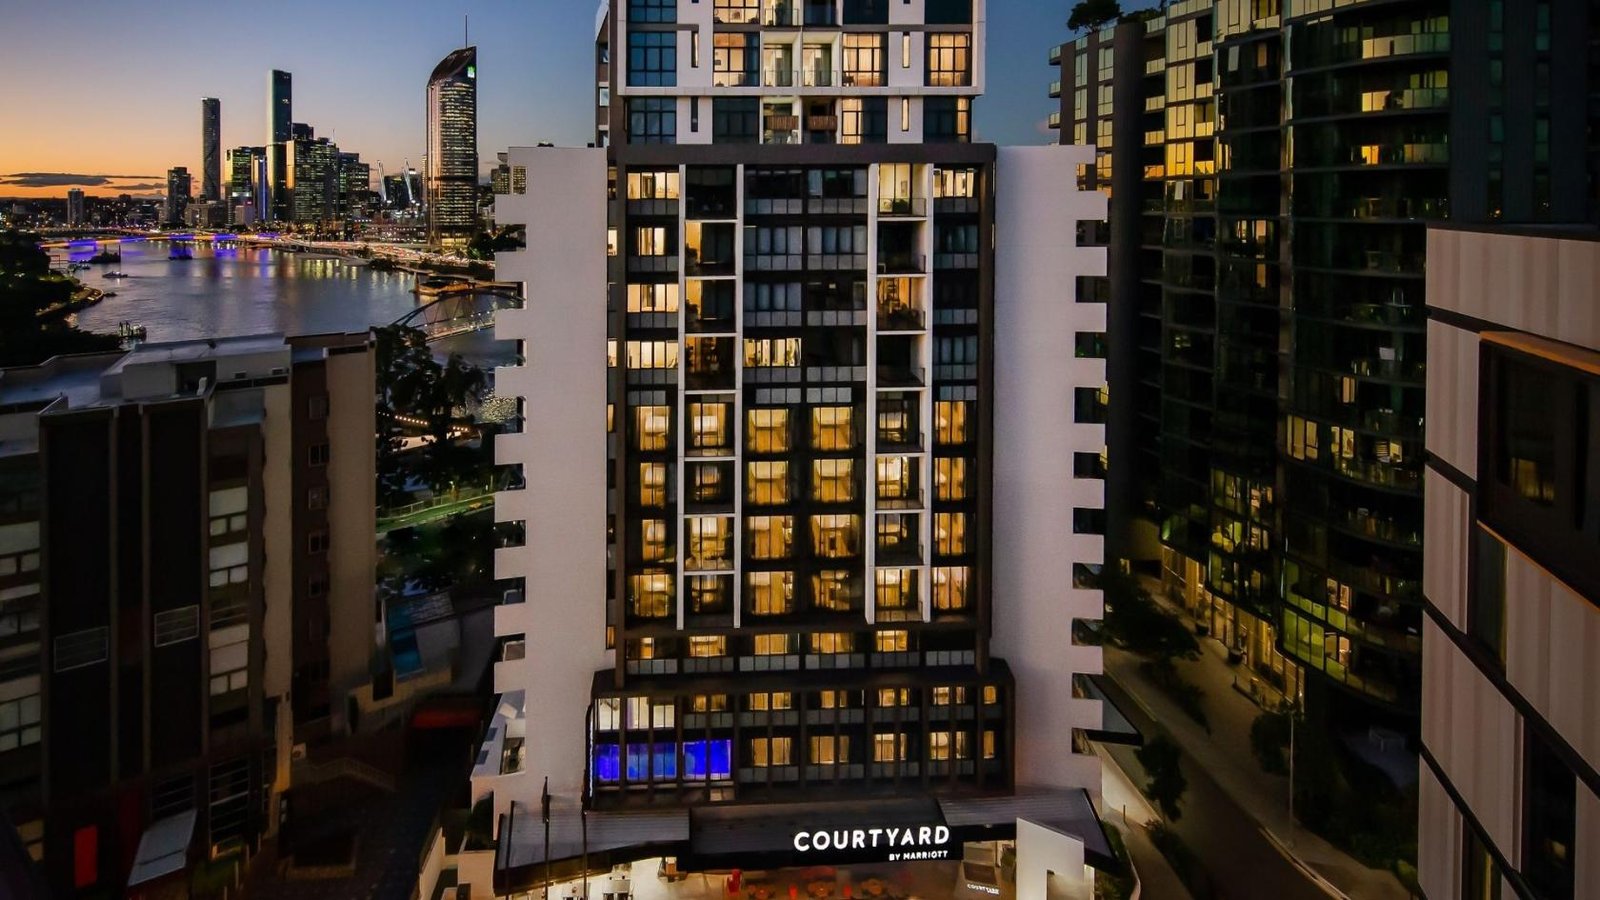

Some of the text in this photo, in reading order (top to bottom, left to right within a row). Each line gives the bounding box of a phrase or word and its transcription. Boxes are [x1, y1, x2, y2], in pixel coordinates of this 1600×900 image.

[793, 825, 950, 851] COURTYARD
[888, 850, 949, 862] BY MARRIOTT
